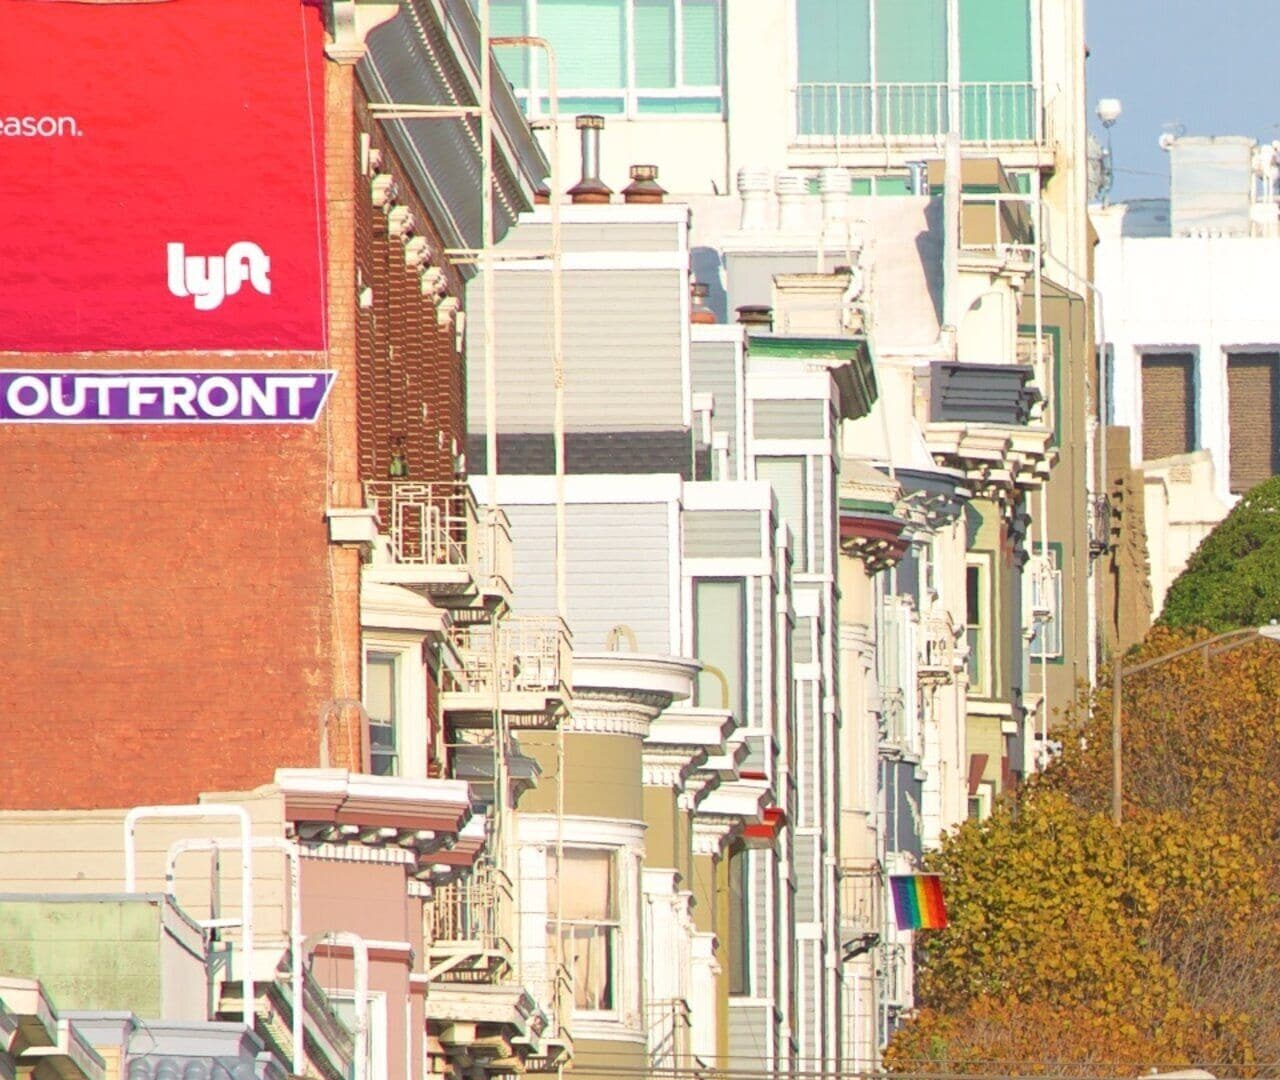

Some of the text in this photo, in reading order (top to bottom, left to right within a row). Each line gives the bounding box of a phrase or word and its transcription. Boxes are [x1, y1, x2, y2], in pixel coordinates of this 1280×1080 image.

[0, 116, 84, 137] ason.
[167, 242, 271, 310] lyft
[7, 376, 317, 417] OUTFRONT
